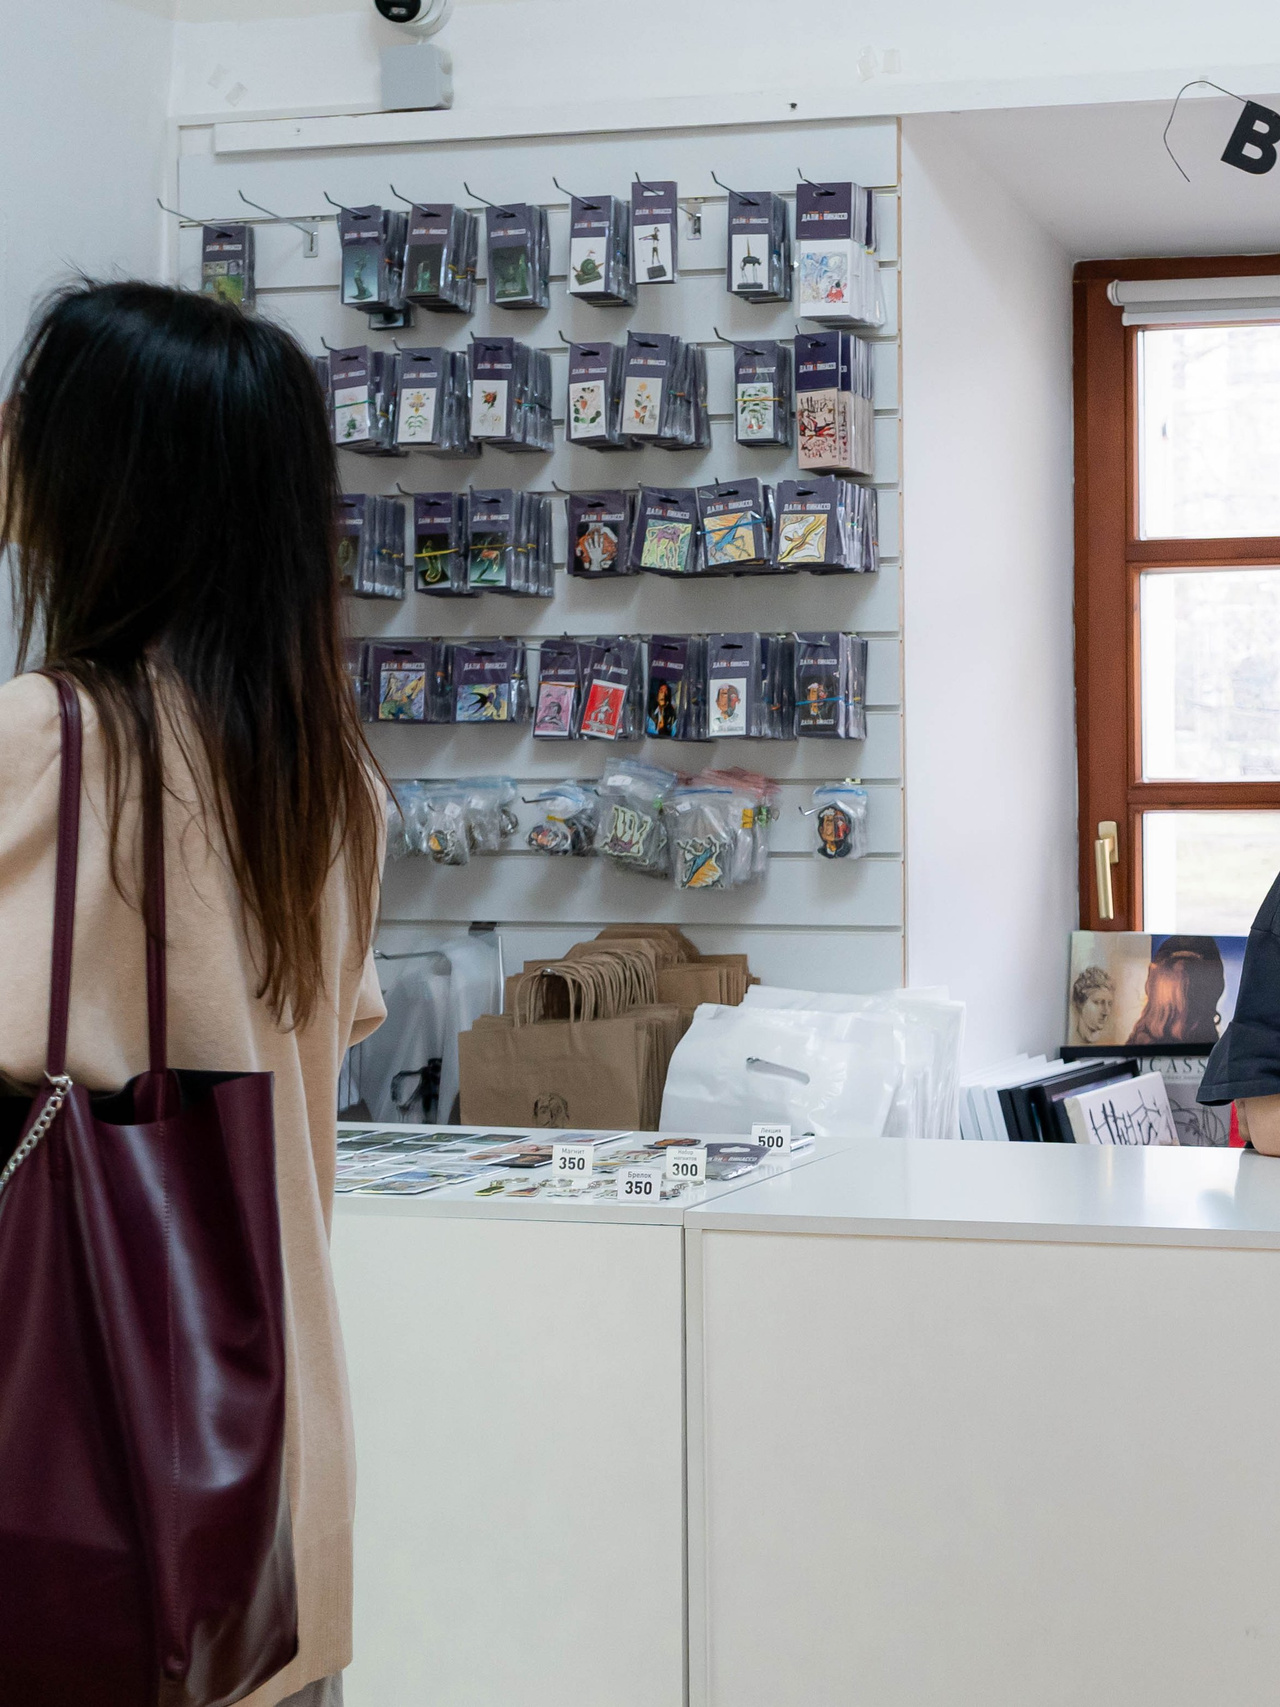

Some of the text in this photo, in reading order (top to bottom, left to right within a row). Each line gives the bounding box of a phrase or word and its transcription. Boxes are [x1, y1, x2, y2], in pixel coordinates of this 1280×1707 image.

[1139, 1056, 1206, 1073] ICASS
[759, 1136, 784, 1148] 500
[562, 1147, 585, 1155] Магнит
[559, 1157, 585, 1171] 350
[672, 1163, 698, 1176] 300
[625, 1181, 653, 1195] 350
